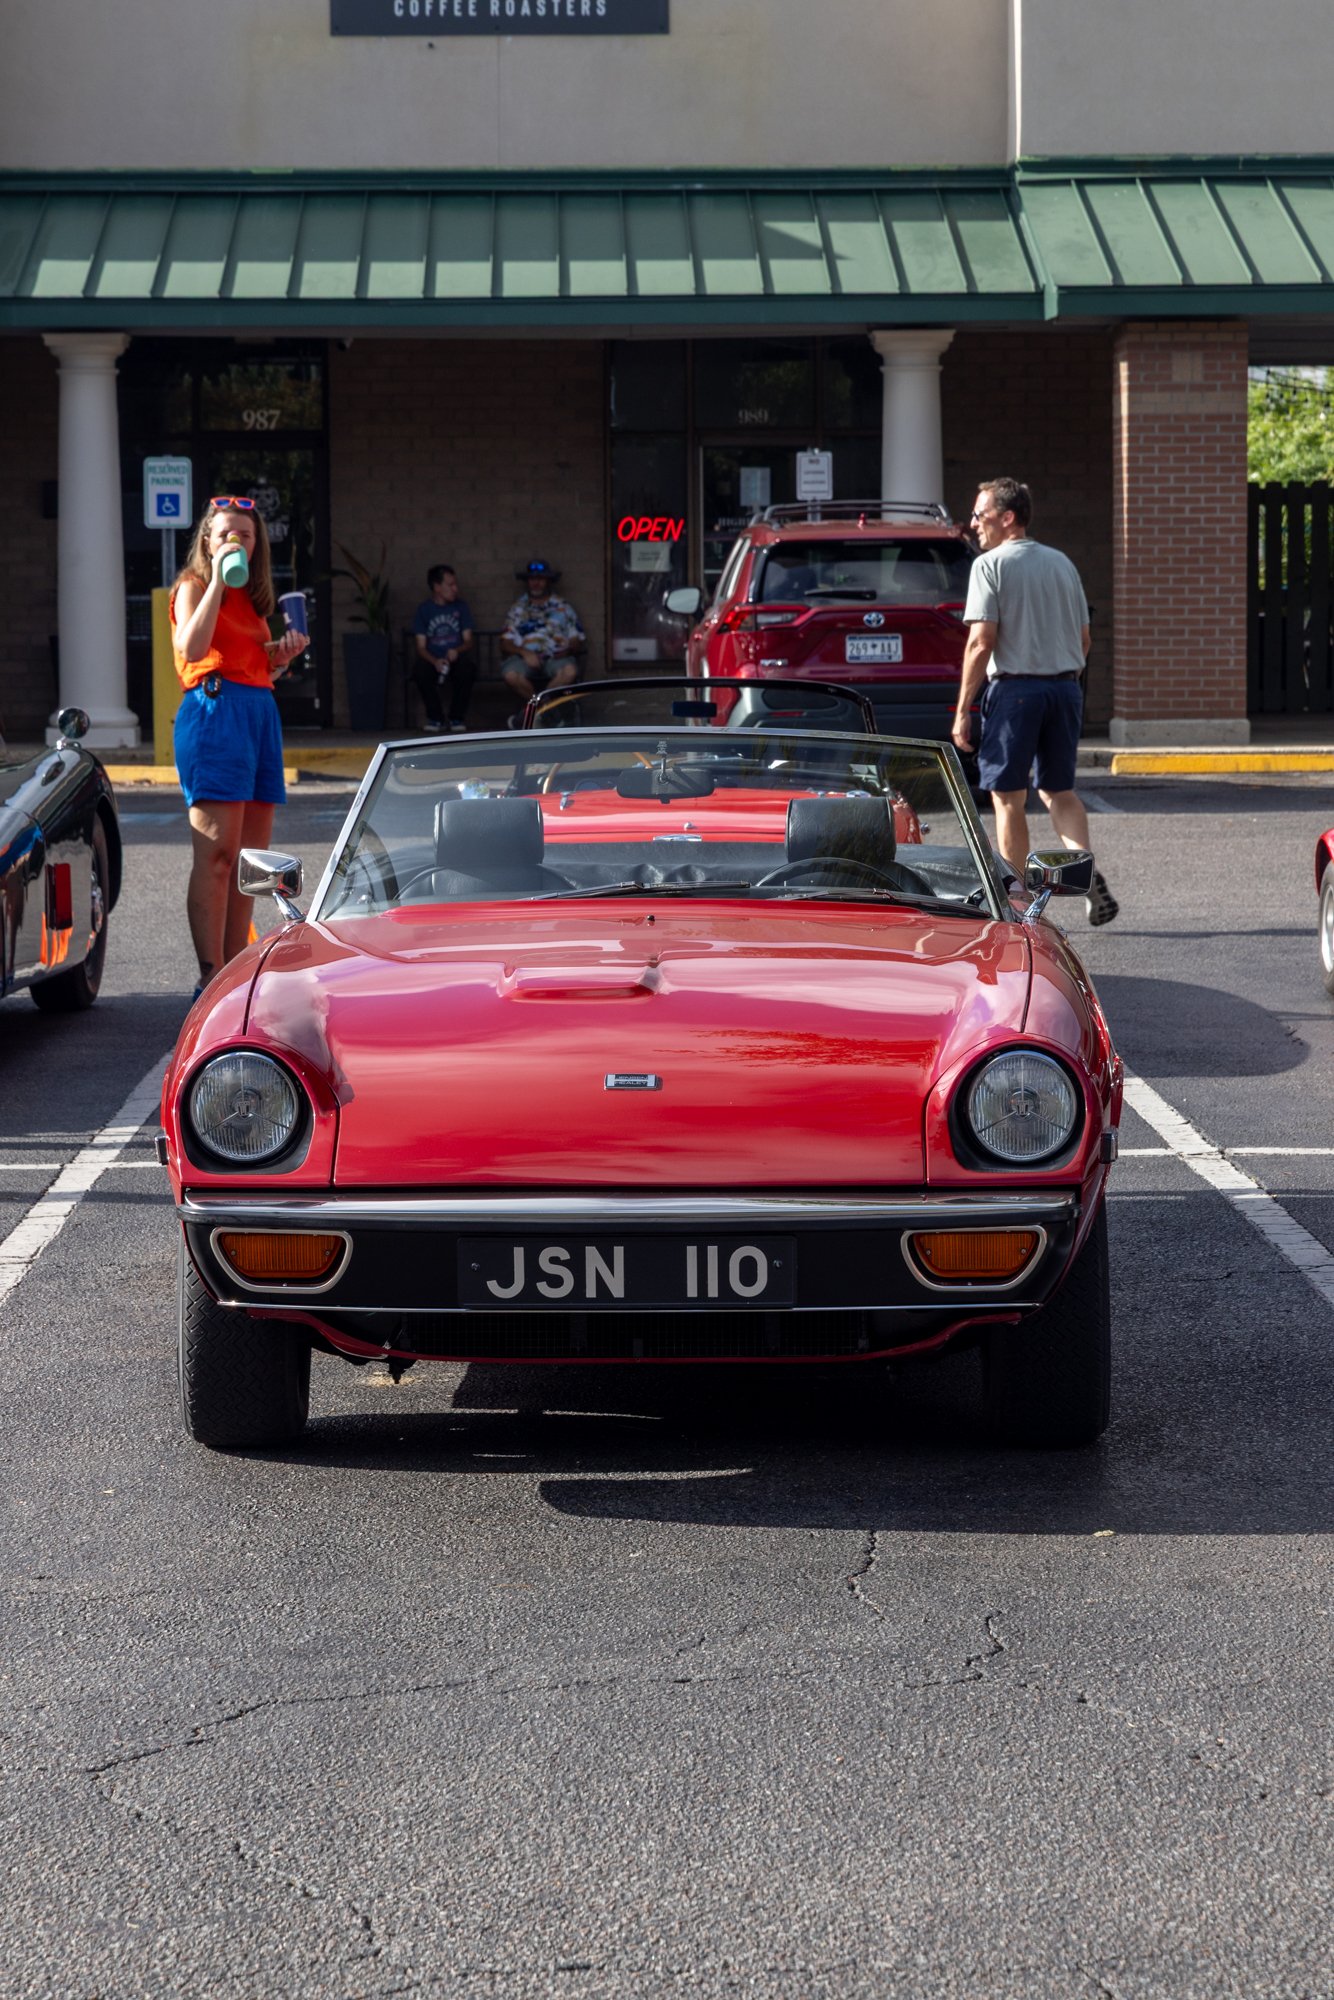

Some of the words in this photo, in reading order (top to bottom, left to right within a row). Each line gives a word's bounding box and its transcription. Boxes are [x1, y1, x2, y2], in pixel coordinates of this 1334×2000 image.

[393, 0, 477, 16] COFFEE
[490, 0, 608, 16] ROASTERS
[242, 409, 281, 431] 987
[738, 407, 769, 425] 989
[150, 476, 185, 486] PARKING
[617, 515, 685, 542] OPEN
[486, 1245, 625, 1299] JSN
[686, 1245, 769, 1298] 110
